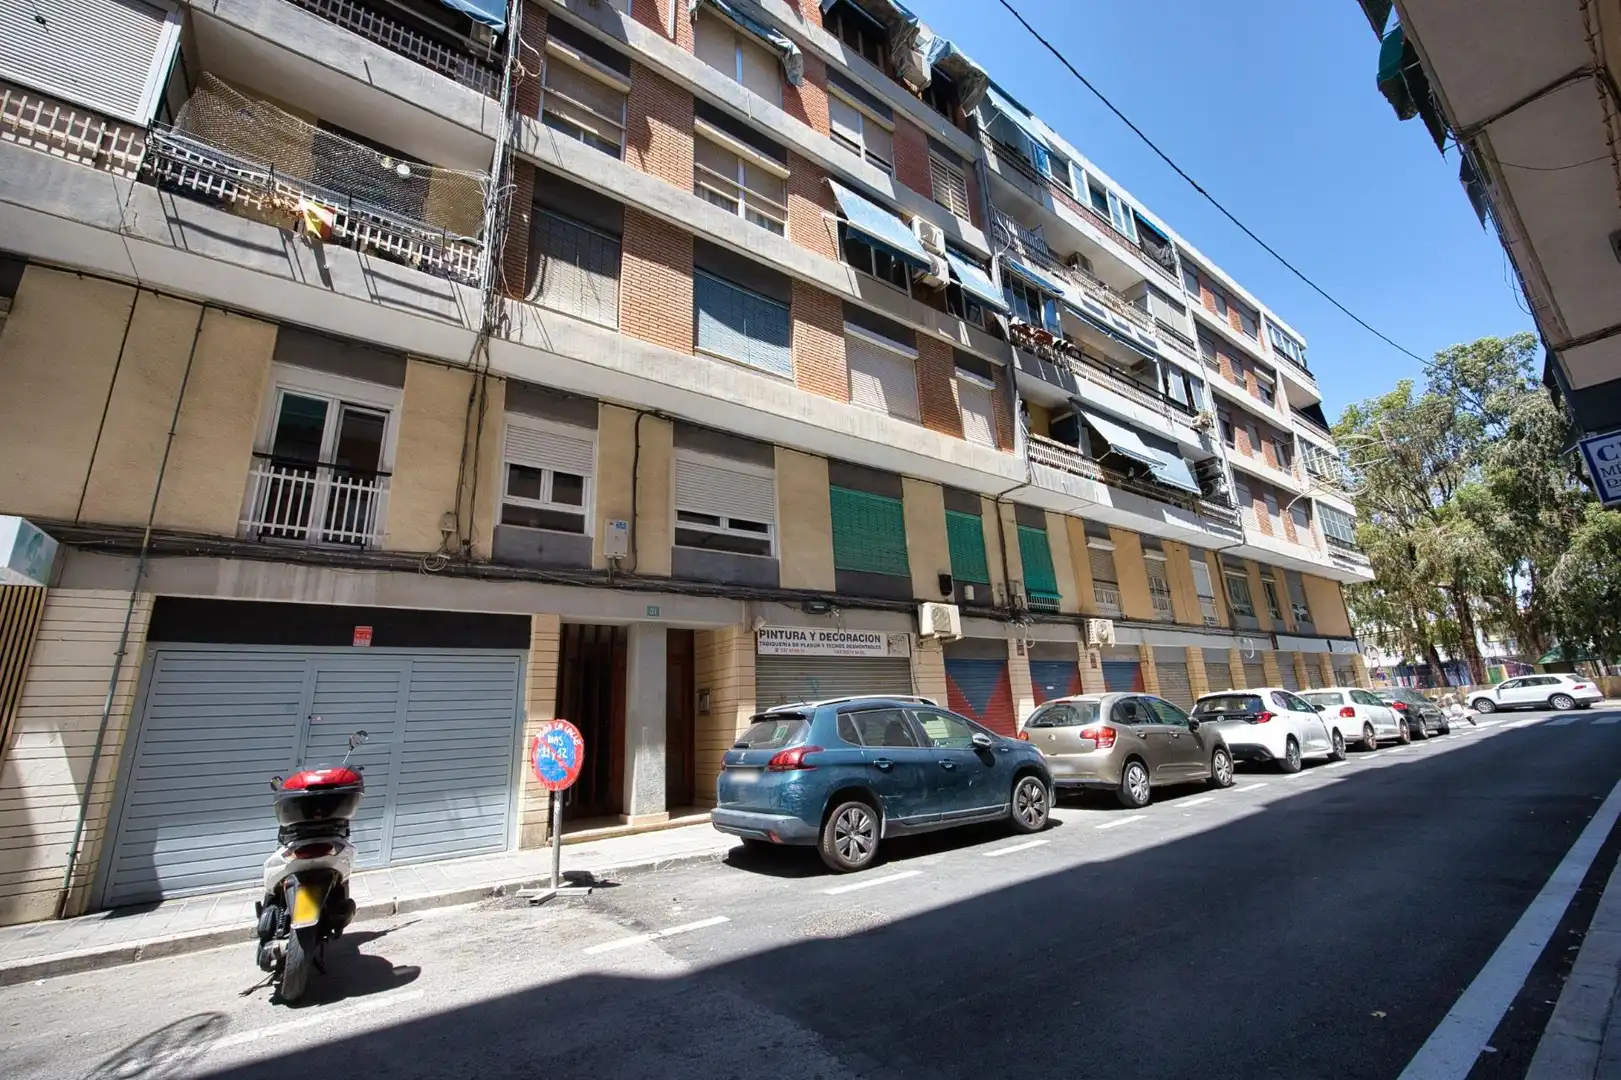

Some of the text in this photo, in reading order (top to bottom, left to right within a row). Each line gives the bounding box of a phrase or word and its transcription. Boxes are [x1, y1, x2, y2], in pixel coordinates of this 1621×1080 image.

[1596, 442, 1621, 461] C
[759, 629, 807, 641] PINTURA
[809, 631, 816, 641] Y
[819, 631, 881, 643] DECORACION
